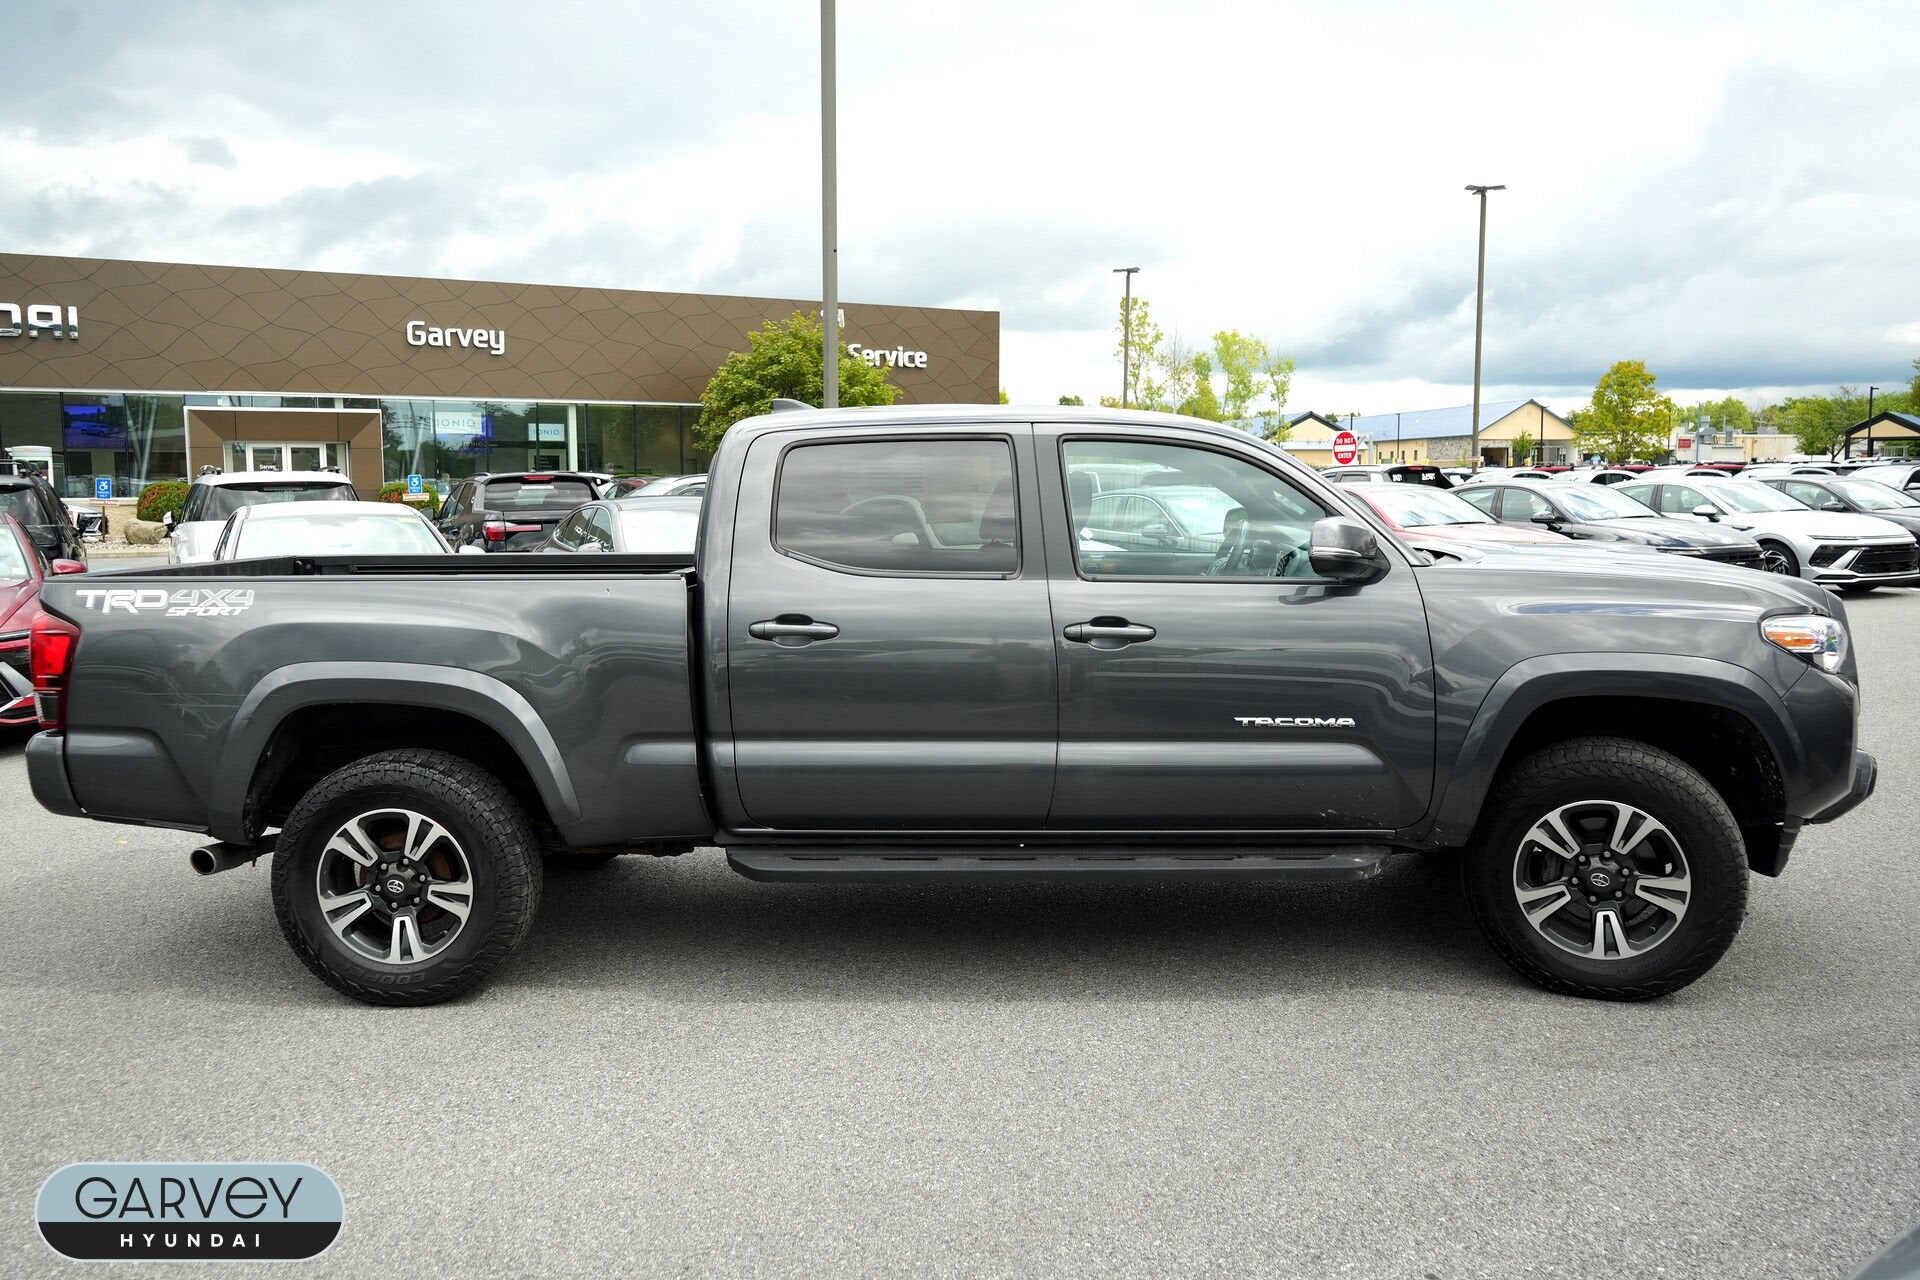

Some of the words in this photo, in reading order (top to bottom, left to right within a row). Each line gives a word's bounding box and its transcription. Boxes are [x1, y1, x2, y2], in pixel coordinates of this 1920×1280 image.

[406, 320, 505, 355] Garvey
[847, 343, 928, 368] Service
[1336, 437, 1344, 445] DO
[76, 589, 168, 615] TRD
[165, 606, 251, 617] SPORT
[1233, 717, 1356, 728] TACOMA
